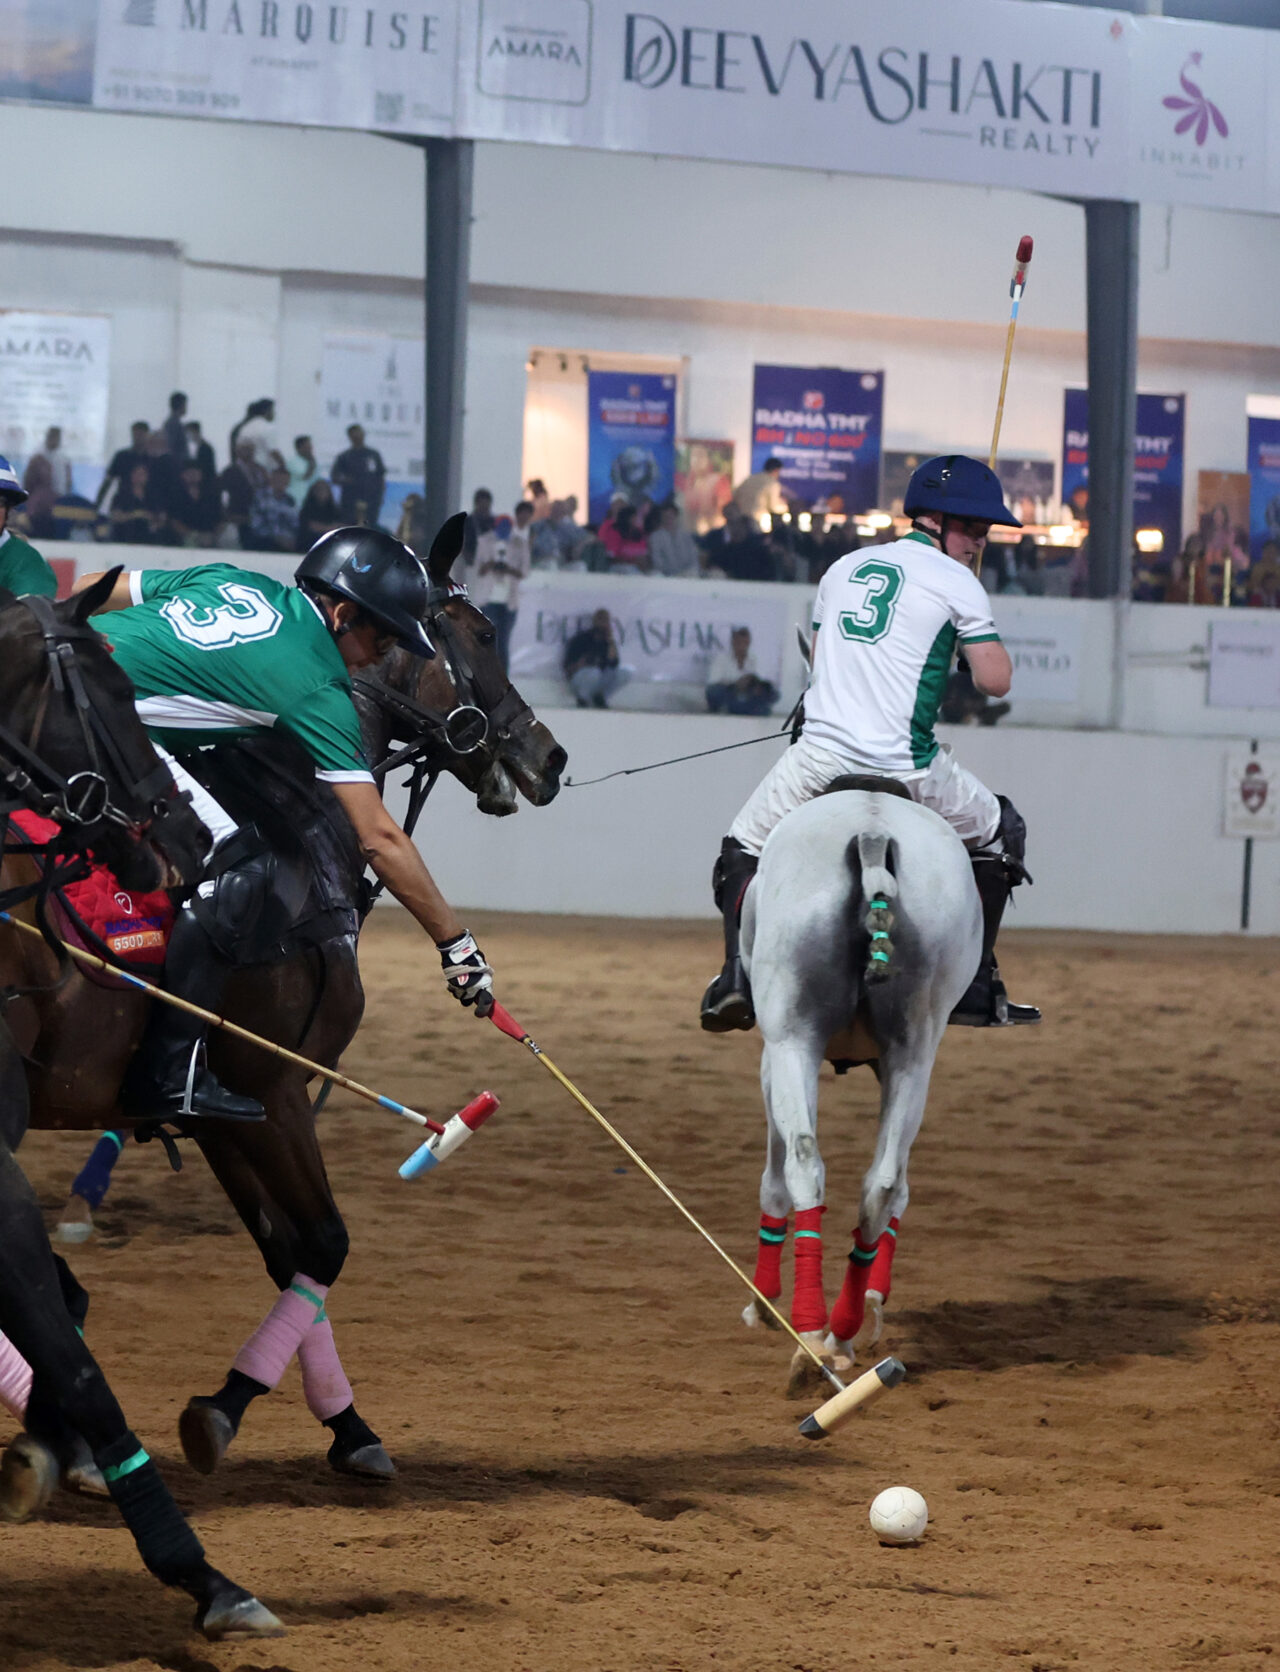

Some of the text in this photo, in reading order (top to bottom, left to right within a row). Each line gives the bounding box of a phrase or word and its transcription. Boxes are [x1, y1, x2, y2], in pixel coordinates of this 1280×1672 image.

[180, 0, 440, 54] MARQUISE
[487, 37, 582, 68] AMARA
[624, 14, 1101, 128] DEEVYASHAKTI
[980, 126, 1100, 159] REALTY
[756, 408, 869, 431] RADHA TMT
[159, 582, 283, 651] 3
[837, 558, 905, 645] 3
